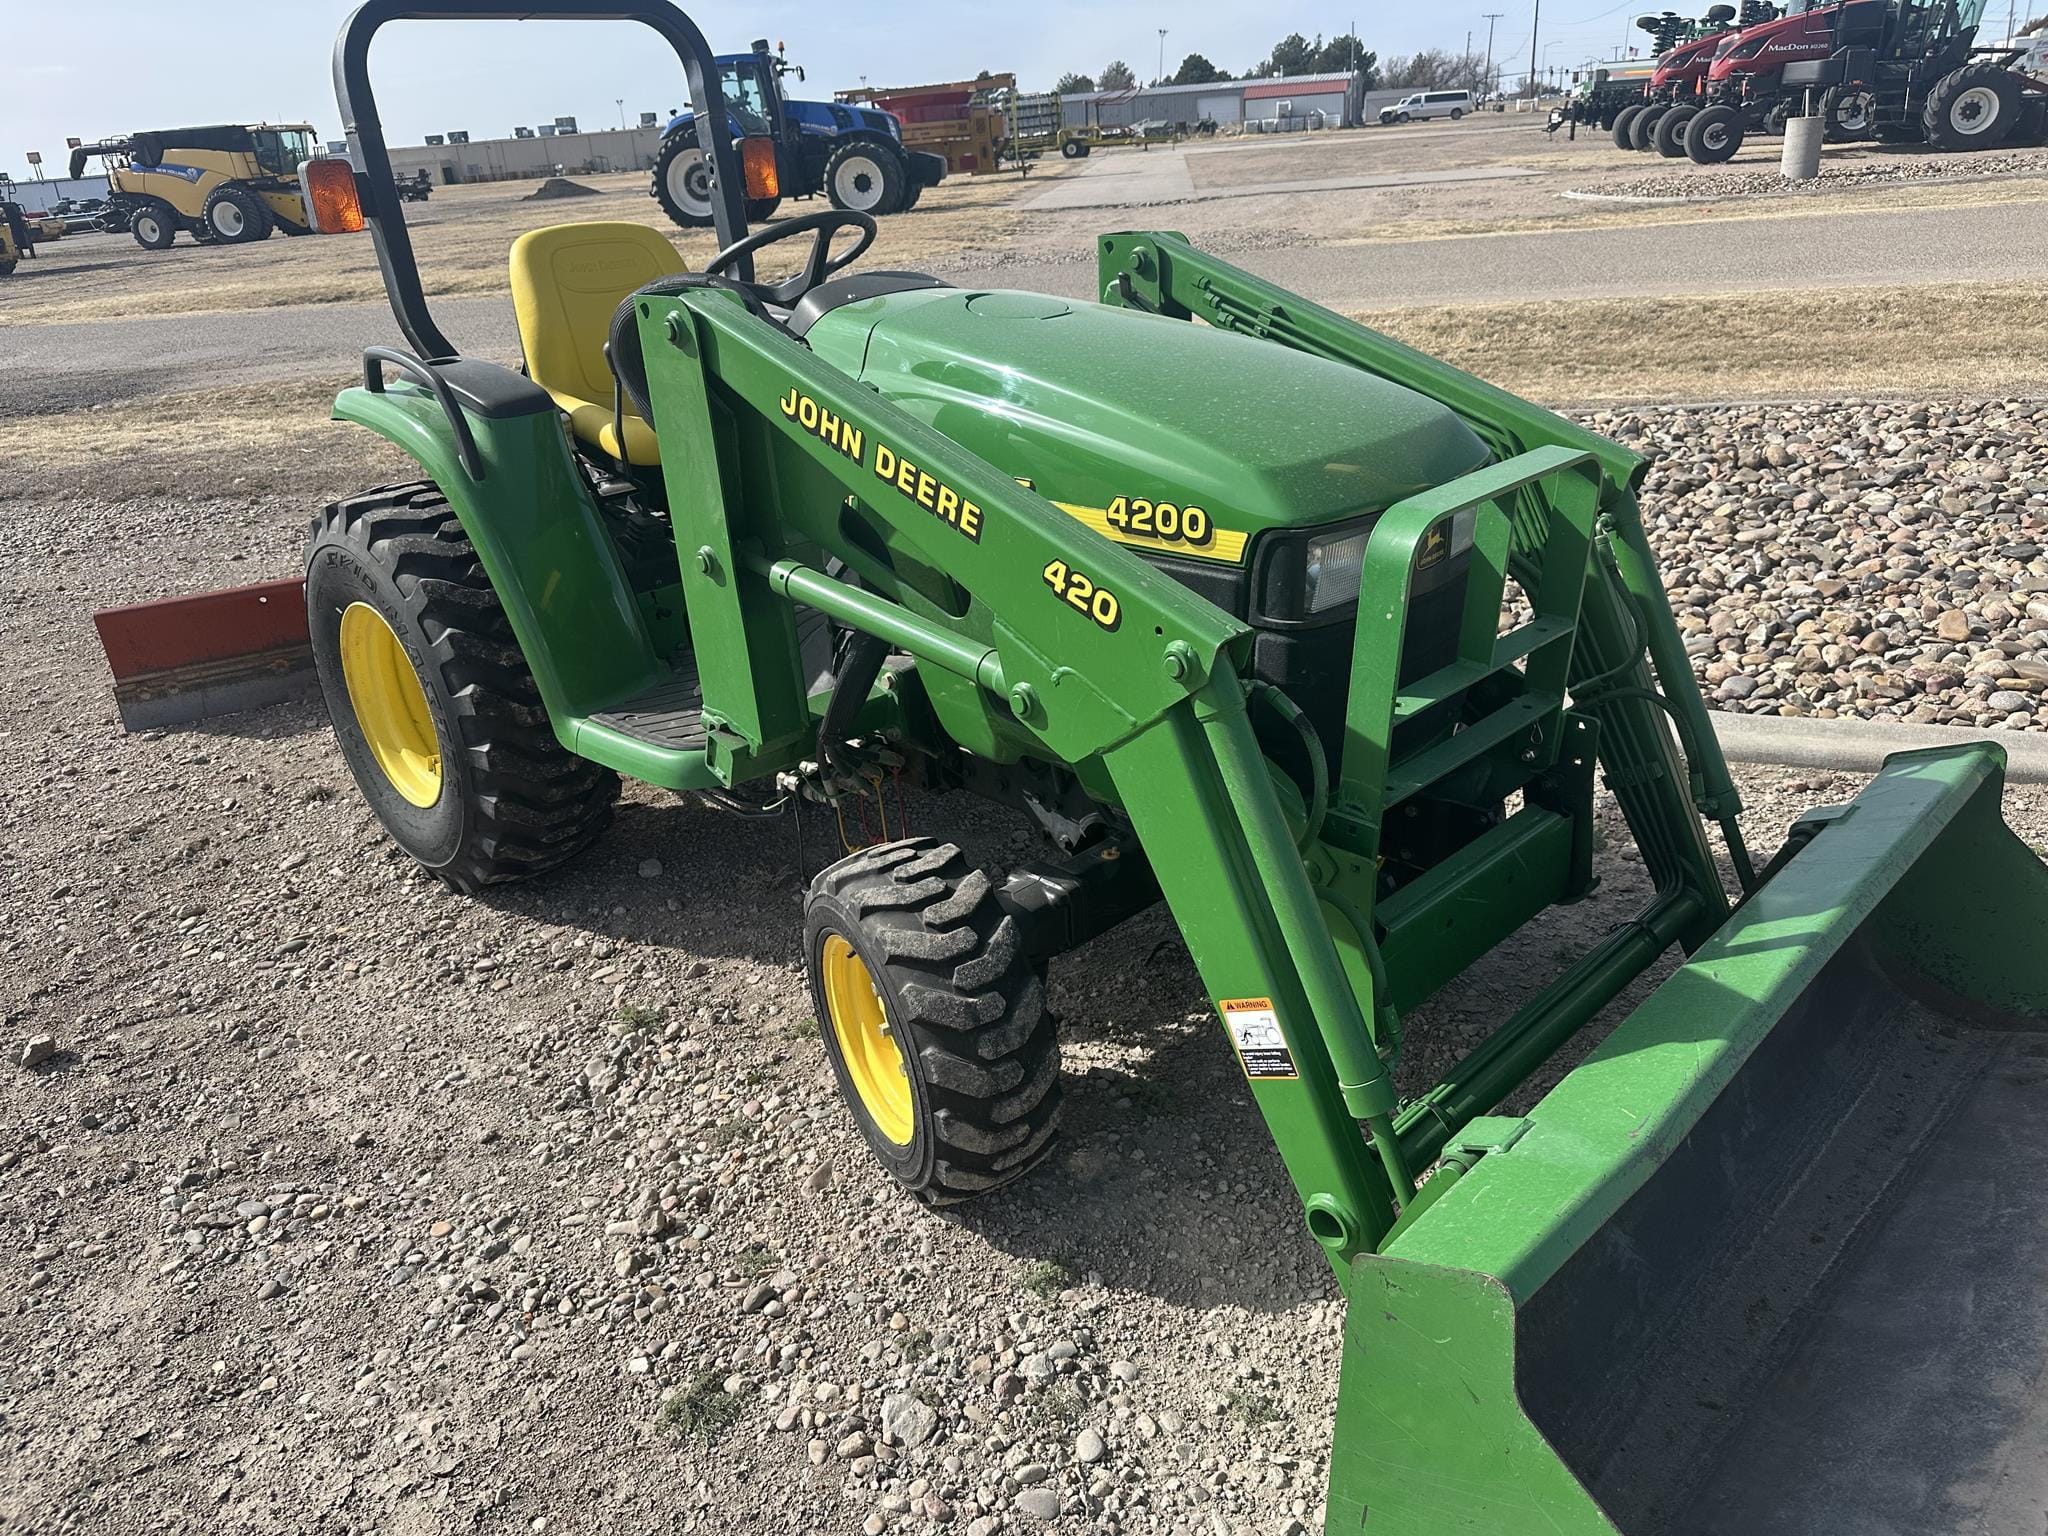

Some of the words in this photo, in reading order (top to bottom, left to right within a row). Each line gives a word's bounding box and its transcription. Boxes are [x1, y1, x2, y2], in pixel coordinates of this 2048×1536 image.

[1769, 43, 1809, 51] MacDon
[779, 386, 866, 468] JOHN
[873, 443, 985, 545] DEERE
[1105, 494, 1214, 546] 4200
[325, 551, 378, 594] SKID
[1042, 557, 1123, 633] 420
[1235, 1000, 1268, 1010] WARNING
